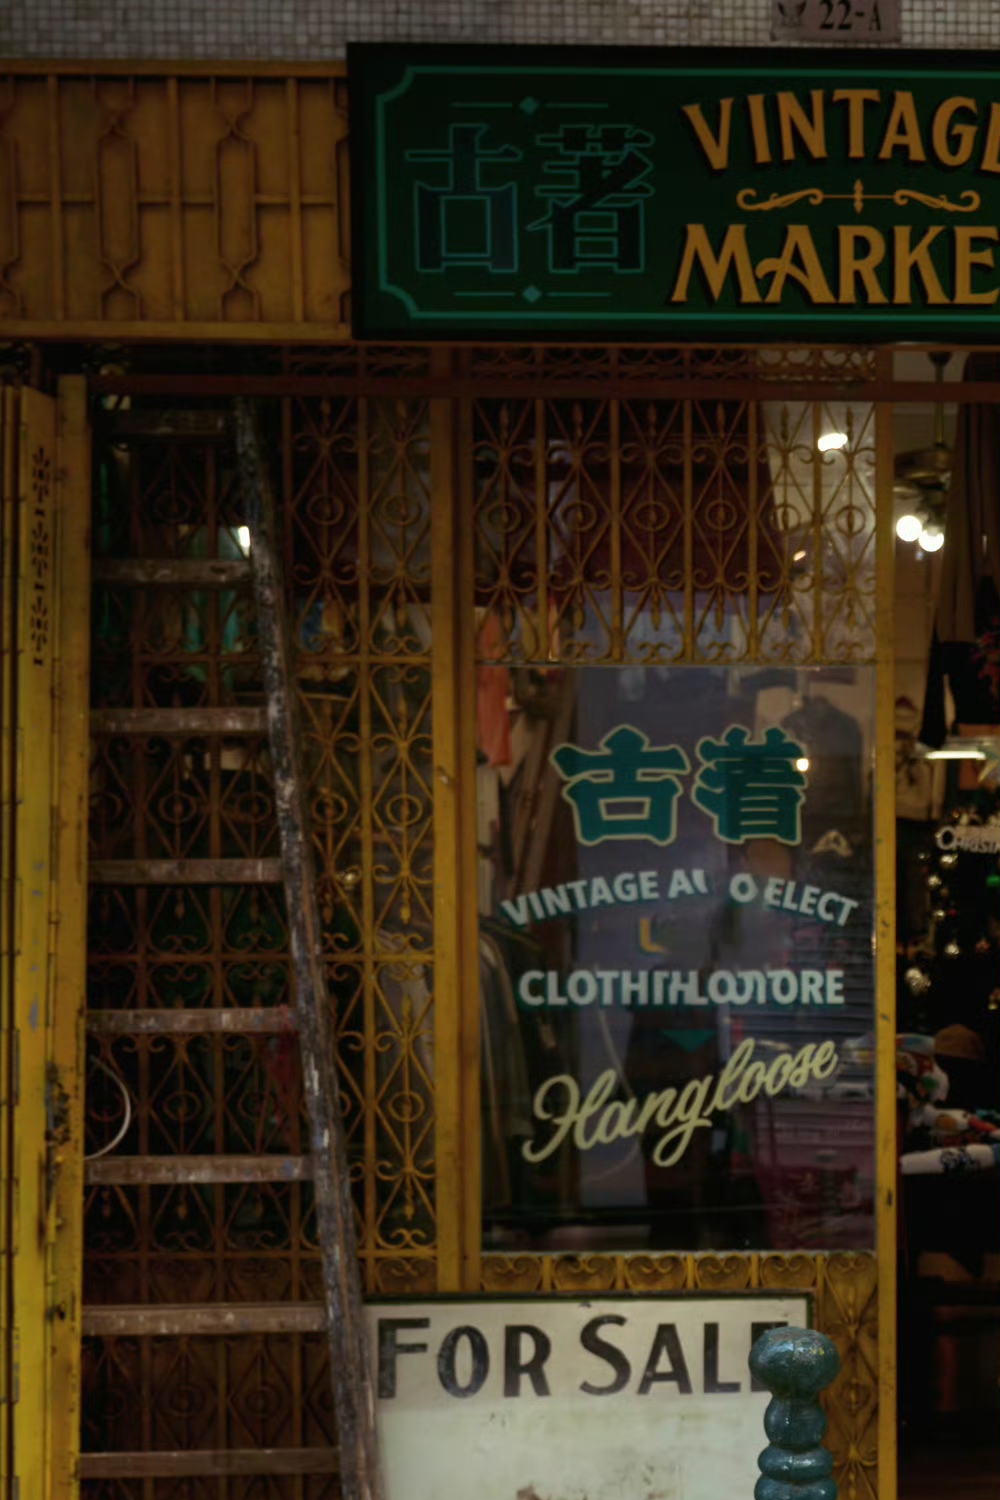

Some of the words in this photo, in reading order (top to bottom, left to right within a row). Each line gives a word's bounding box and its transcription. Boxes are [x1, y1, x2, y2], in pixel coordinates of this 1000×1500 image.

[404, 122, 656, 275] 古著
[501, 869, 662, 928] VINTAGE
[377, 1317, 552, 1399] FOR
